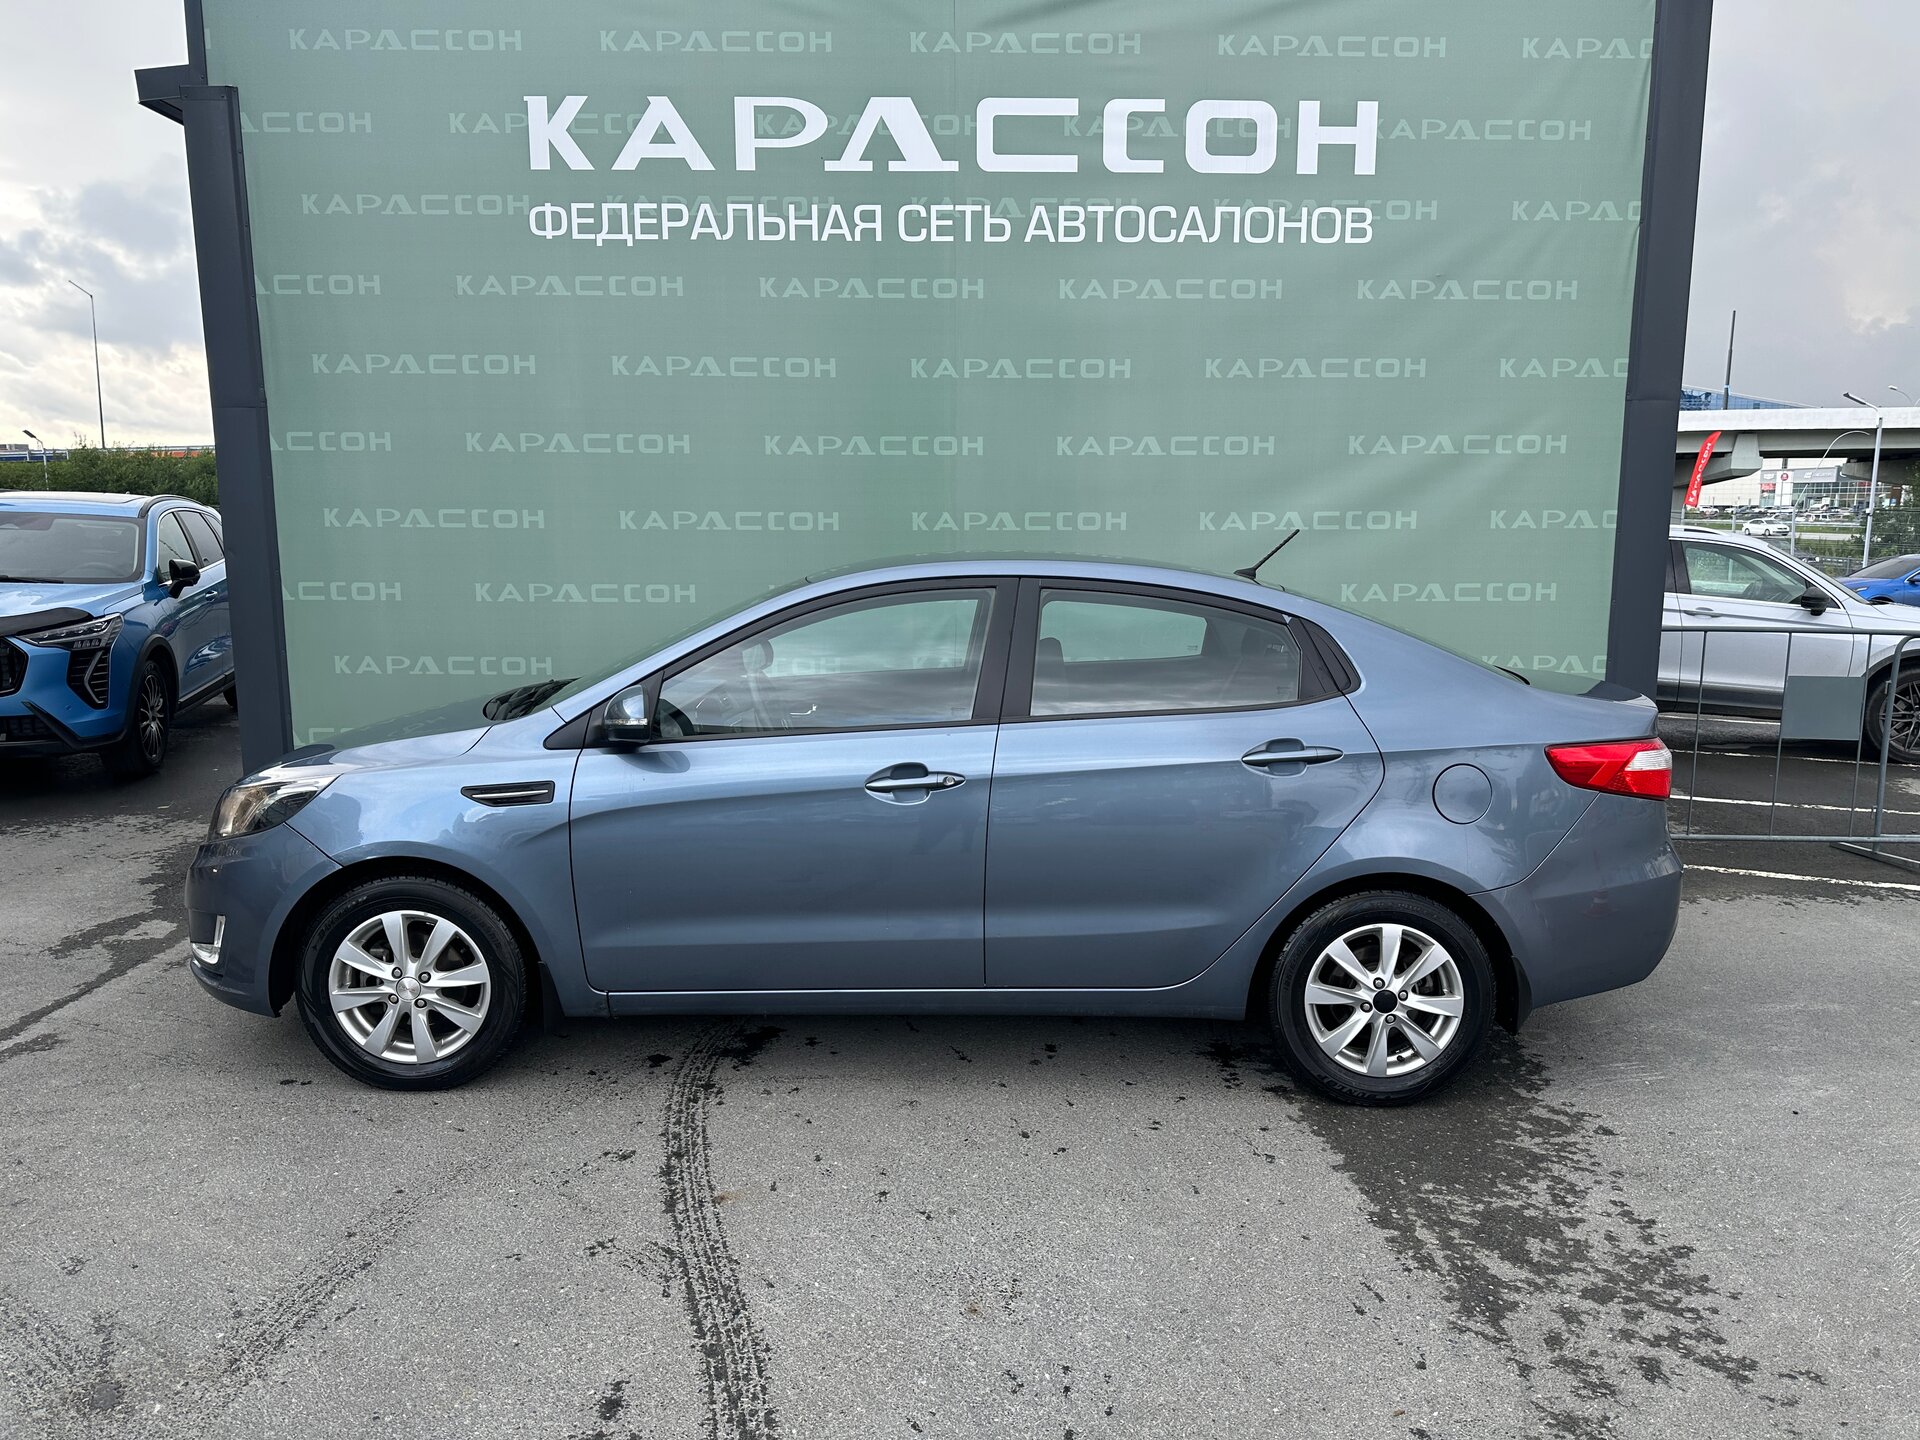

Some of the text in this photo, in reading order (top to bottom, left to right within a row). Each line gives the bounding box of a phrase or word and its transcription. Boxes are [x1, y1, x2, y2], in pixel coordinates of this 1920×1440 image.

[529, 203, 1373, 247] ФЕДЕРАЛЬНАЯ СЕТЬ АВТОСАЛОНОВ
